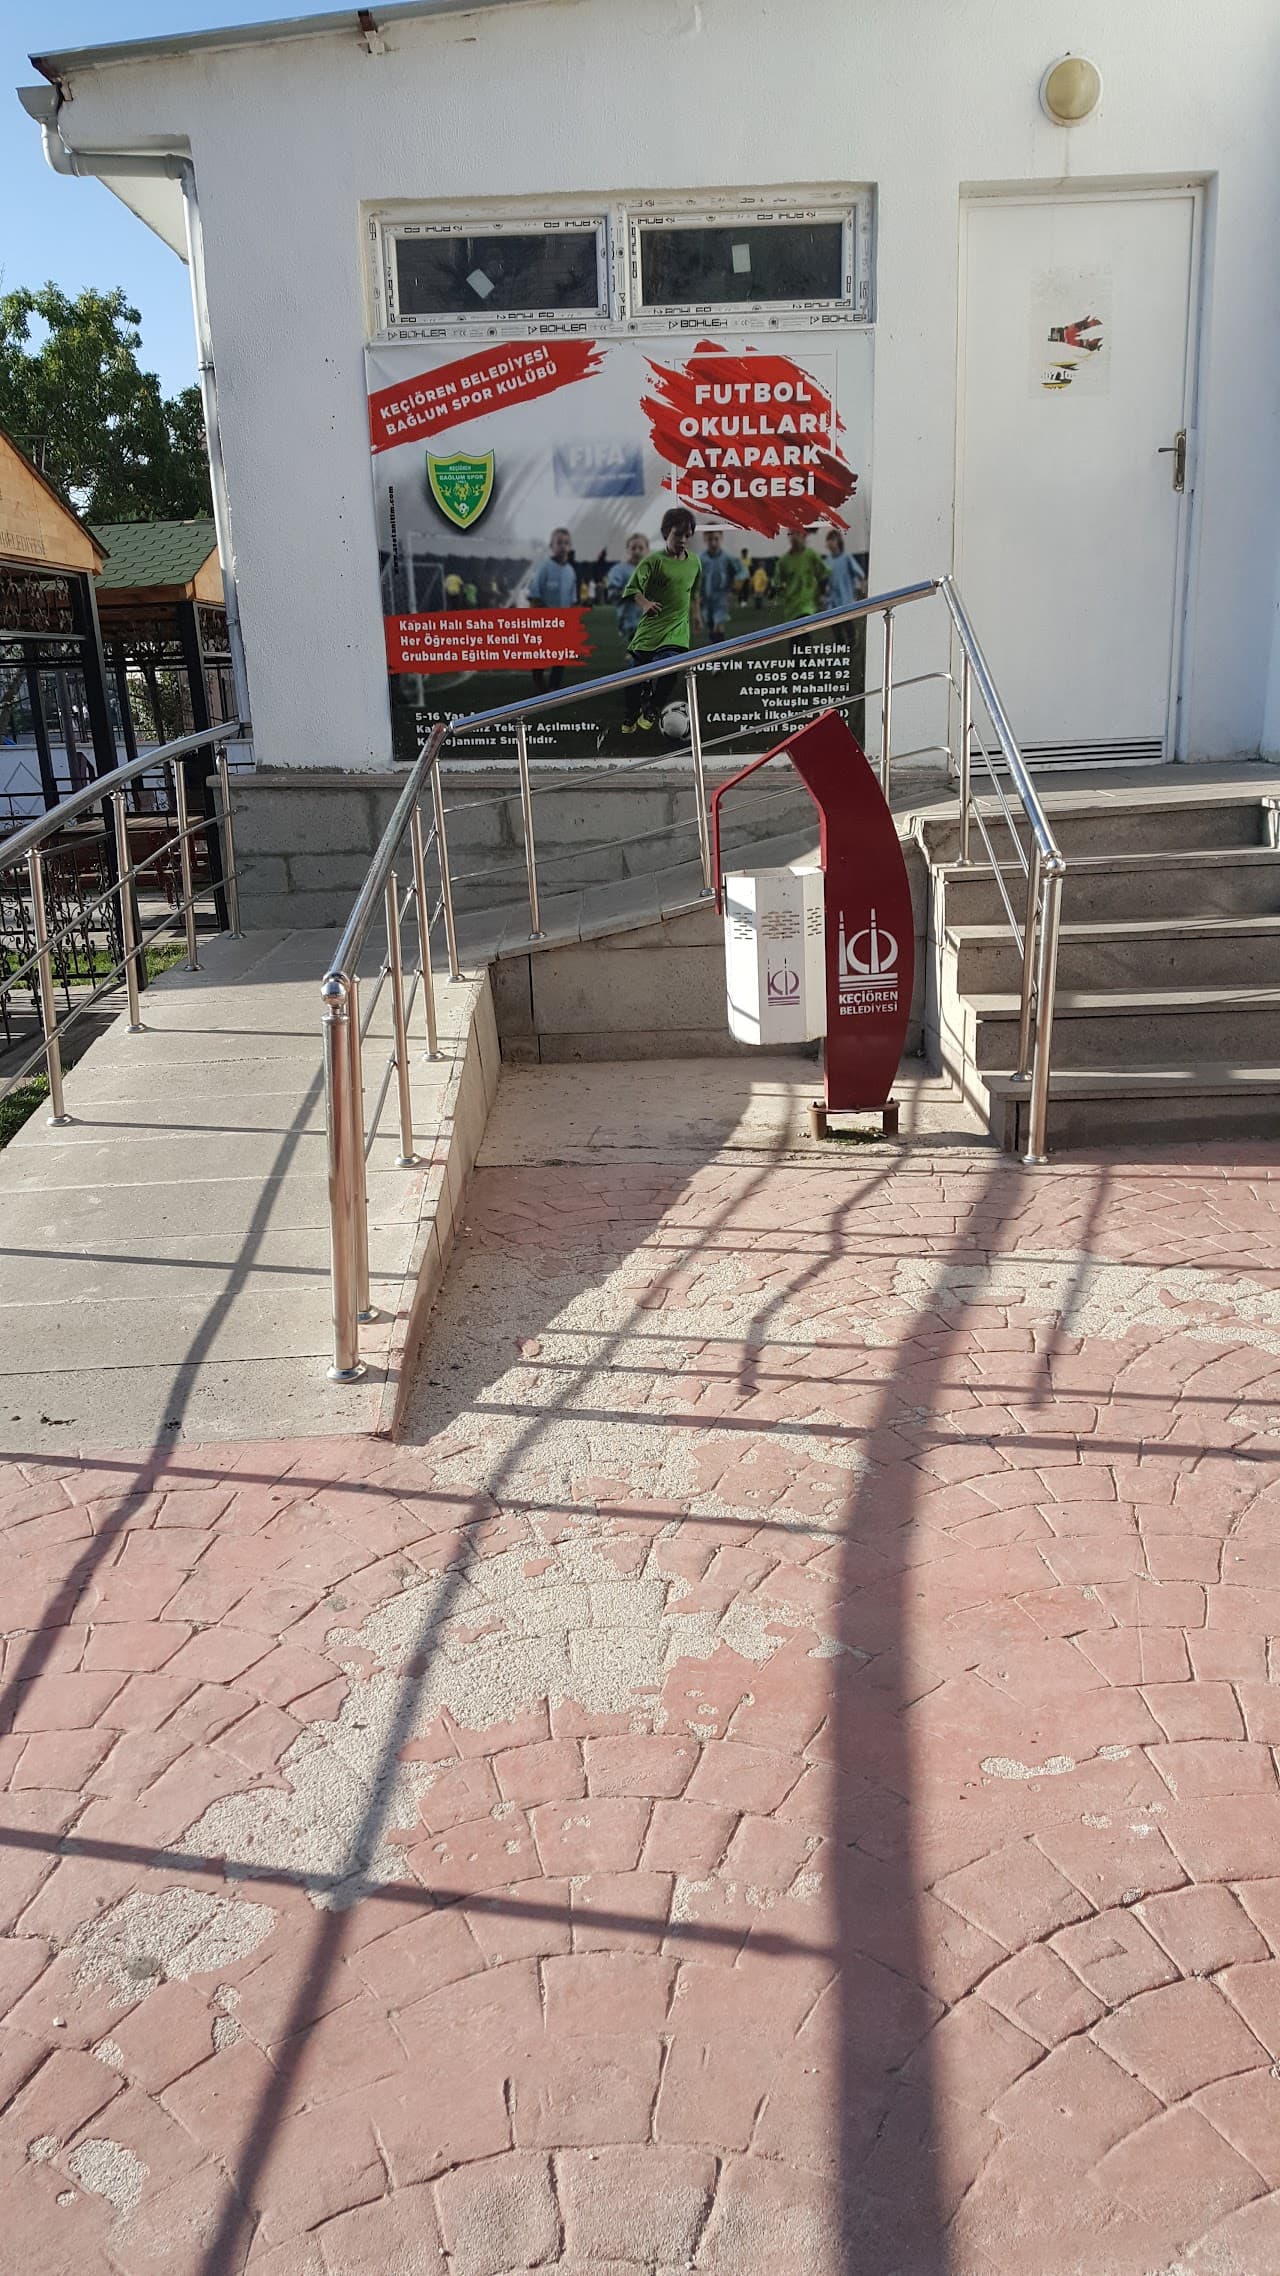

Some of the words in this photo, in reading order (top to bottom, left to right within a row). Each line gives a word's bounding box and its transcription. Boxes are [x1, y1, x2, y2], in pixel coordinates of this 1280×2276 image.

[380, 383, 456, 419] KEÇİÖREN
[461, 346, 549, 390] BELEDİYESİ
[386, 404, 448, 435] BAĞLUM
[453, 389, 493, 411] SPOR
[496, 361, 558, 394] KULÜBÜ
[695, 381, 812, 405] FUTBOL
[679, 413, 828, 438] OKULLARI
[686, 445, 821, 469] ATAPARK
[692, 471, 815, 499] BÖLGESİ
[399, 619, 436, 632] Kapalı
[439, 619, 462, 630] Halı
[466, 618, 494, 630] Saha
[497, 617, 565, 629] Tesisimizde
[400, 635, 421, 646] Her
[424, 633, 483, 648] Öğrenciye
[487, 633, 519, 645] Kendi
[523, 633, 543, 646] Yaş
[401, 650, 458, 662] Grubunda
[461, 649, 499, 663] Eğitim
[502, 648, 579, 661] Vermekteyiz.
[792, 642, 851, 656] İLETİŞİM:
[747, 660, 796, 670] TAYFUN
[799, 657, 850, 668] KANTAR
[755, 672, 787, 682] 0505
[791, 671, 815, 681] 045
[819, 671, 831, 680] 12
[835, 670, 850, 679] 92
[739, 684, 788, 697] Atapark
[792, 682, 850, 694] Mahallesi
[761, 696, 809, 708] Yokuşlu
[415, 712, 440, 721] 5-16
[707, 711, 761, 723] (Atapark
[494, 722, 533, 732] Tekr
[536, 721, 600, 732] Açılmıştır.
[839, 990, 899, 1006] KEÇİÖREN
[839, 1002, 898, 1016] BELEDİYESİ
